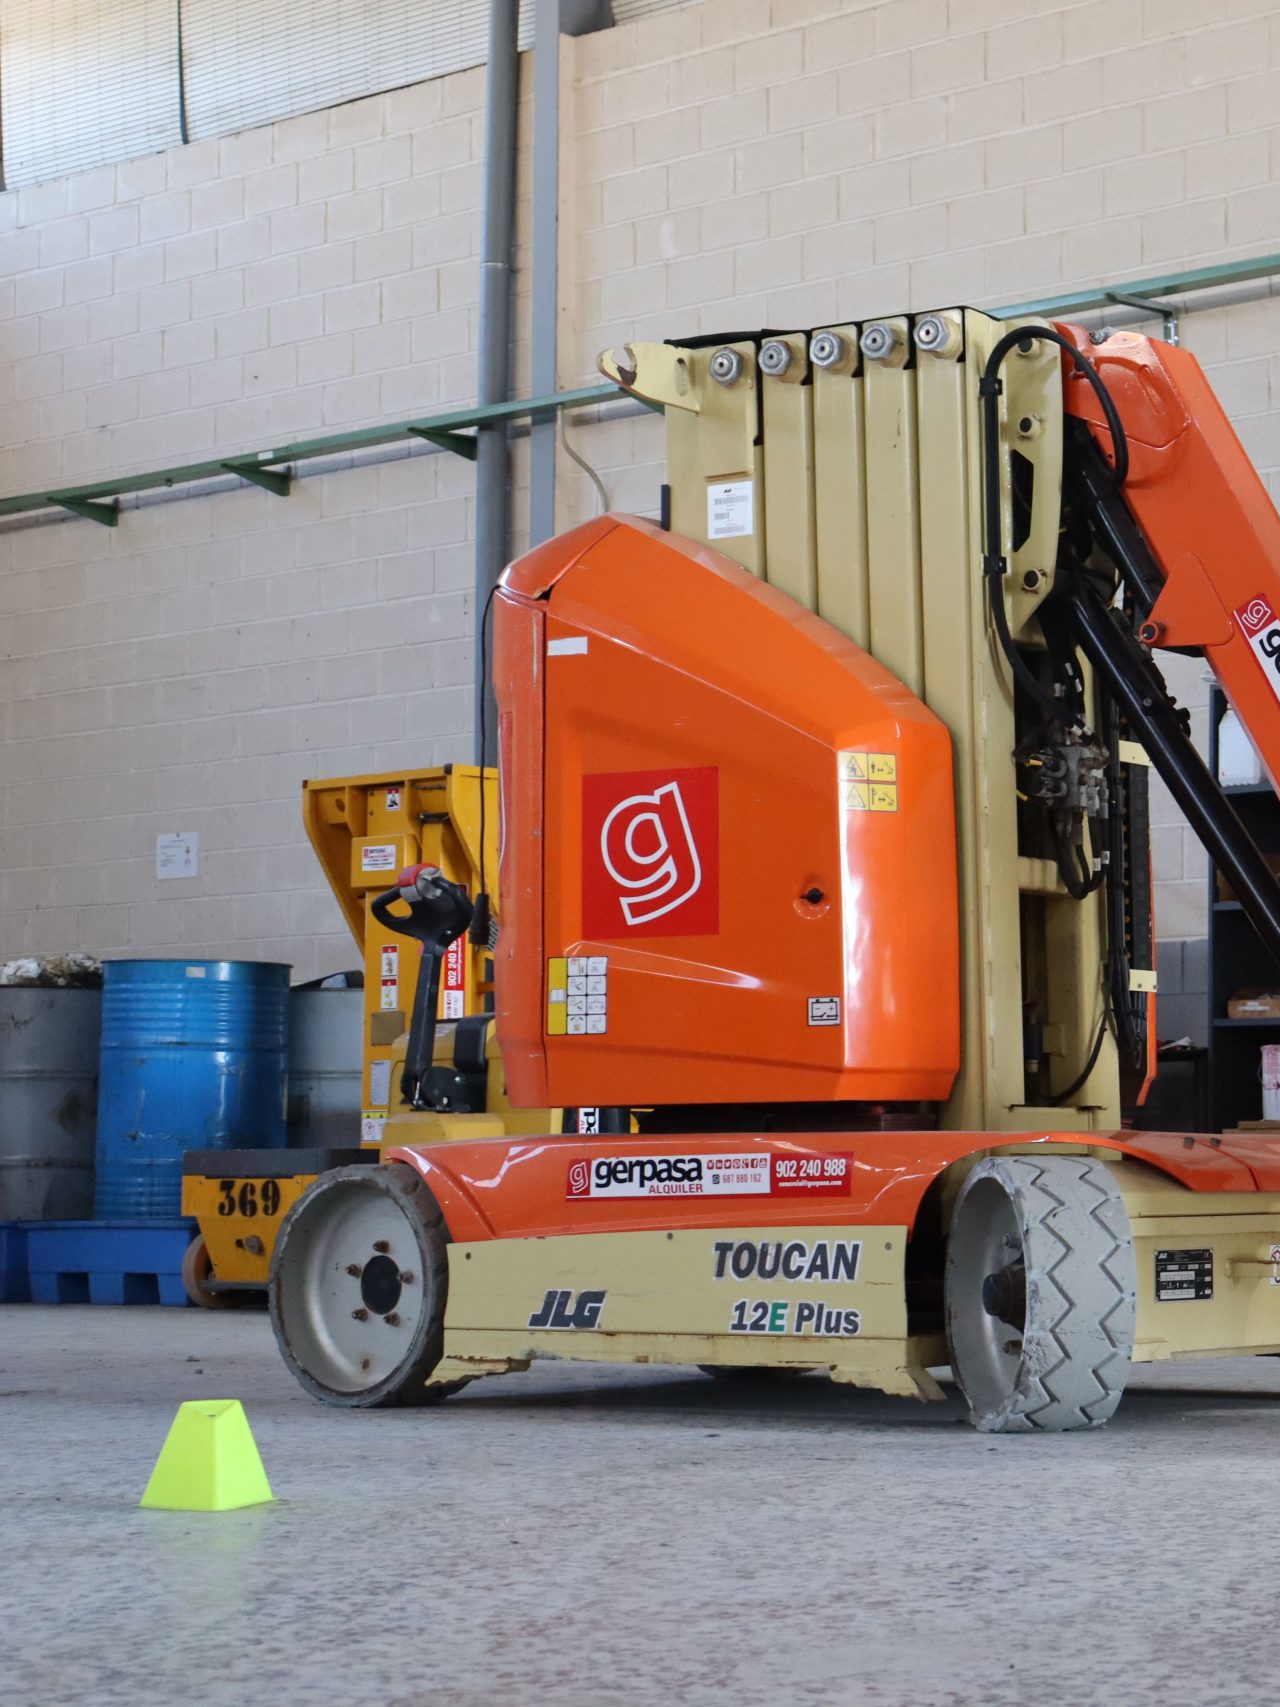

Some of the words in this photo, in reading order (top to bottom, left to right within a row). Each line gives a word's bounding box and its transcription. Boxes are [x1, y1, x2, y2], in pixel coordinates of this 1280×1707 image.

[594, 1157, 704, 1188] gerpasa
[776, 1160, 798, 1178] 902
[800, 1159, 821, 1177] 240
[823, 1158, 846, 1176] 988
[218, 1179, 281, 1217] 369
[648, 1183, 704, 1194] ALQUILER
[713, 1241, 862, 1281] TOUCAN
[527, 1289, 608, 1329] JLG
[730, 1300, 789, 1333] 12E
[794, 1302, 861, 1335] Plus
